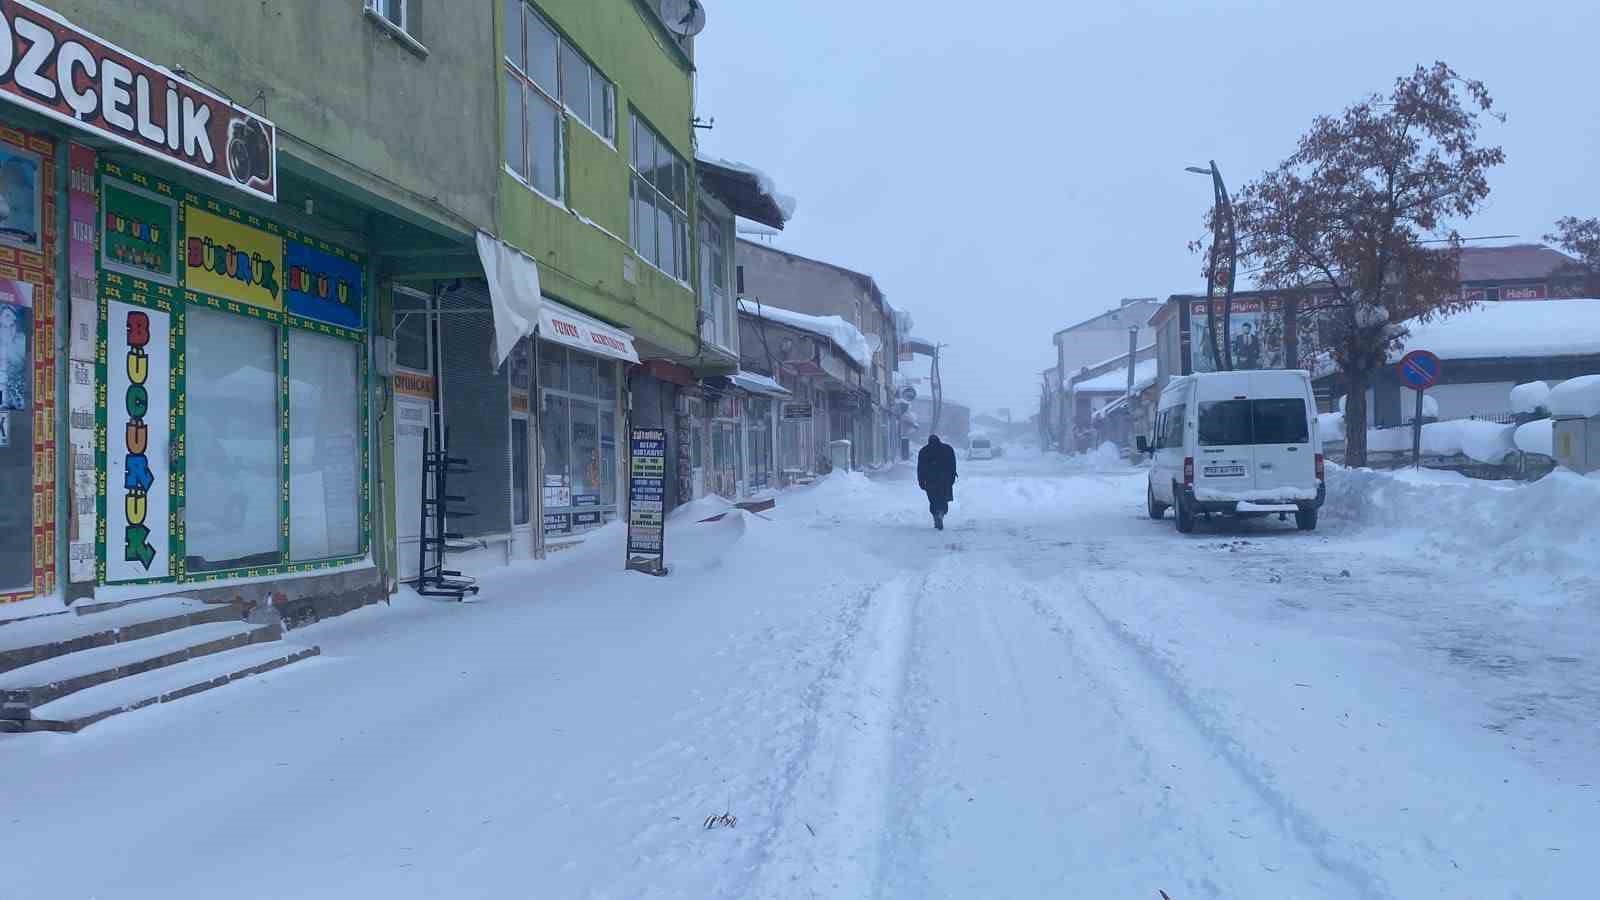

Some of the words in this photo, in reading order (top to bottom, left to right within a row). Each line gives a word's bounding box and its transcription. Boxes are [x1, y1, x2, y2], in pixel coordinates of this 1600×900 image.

[107, 212, 168, 246] BÜÜRÜ
[188, 235, 280, 301] BÜCÜRÜK
[289, 265, 355, 306] BÜÜÜ
[124, 310, 156, 571] BÜCÜRÜK
